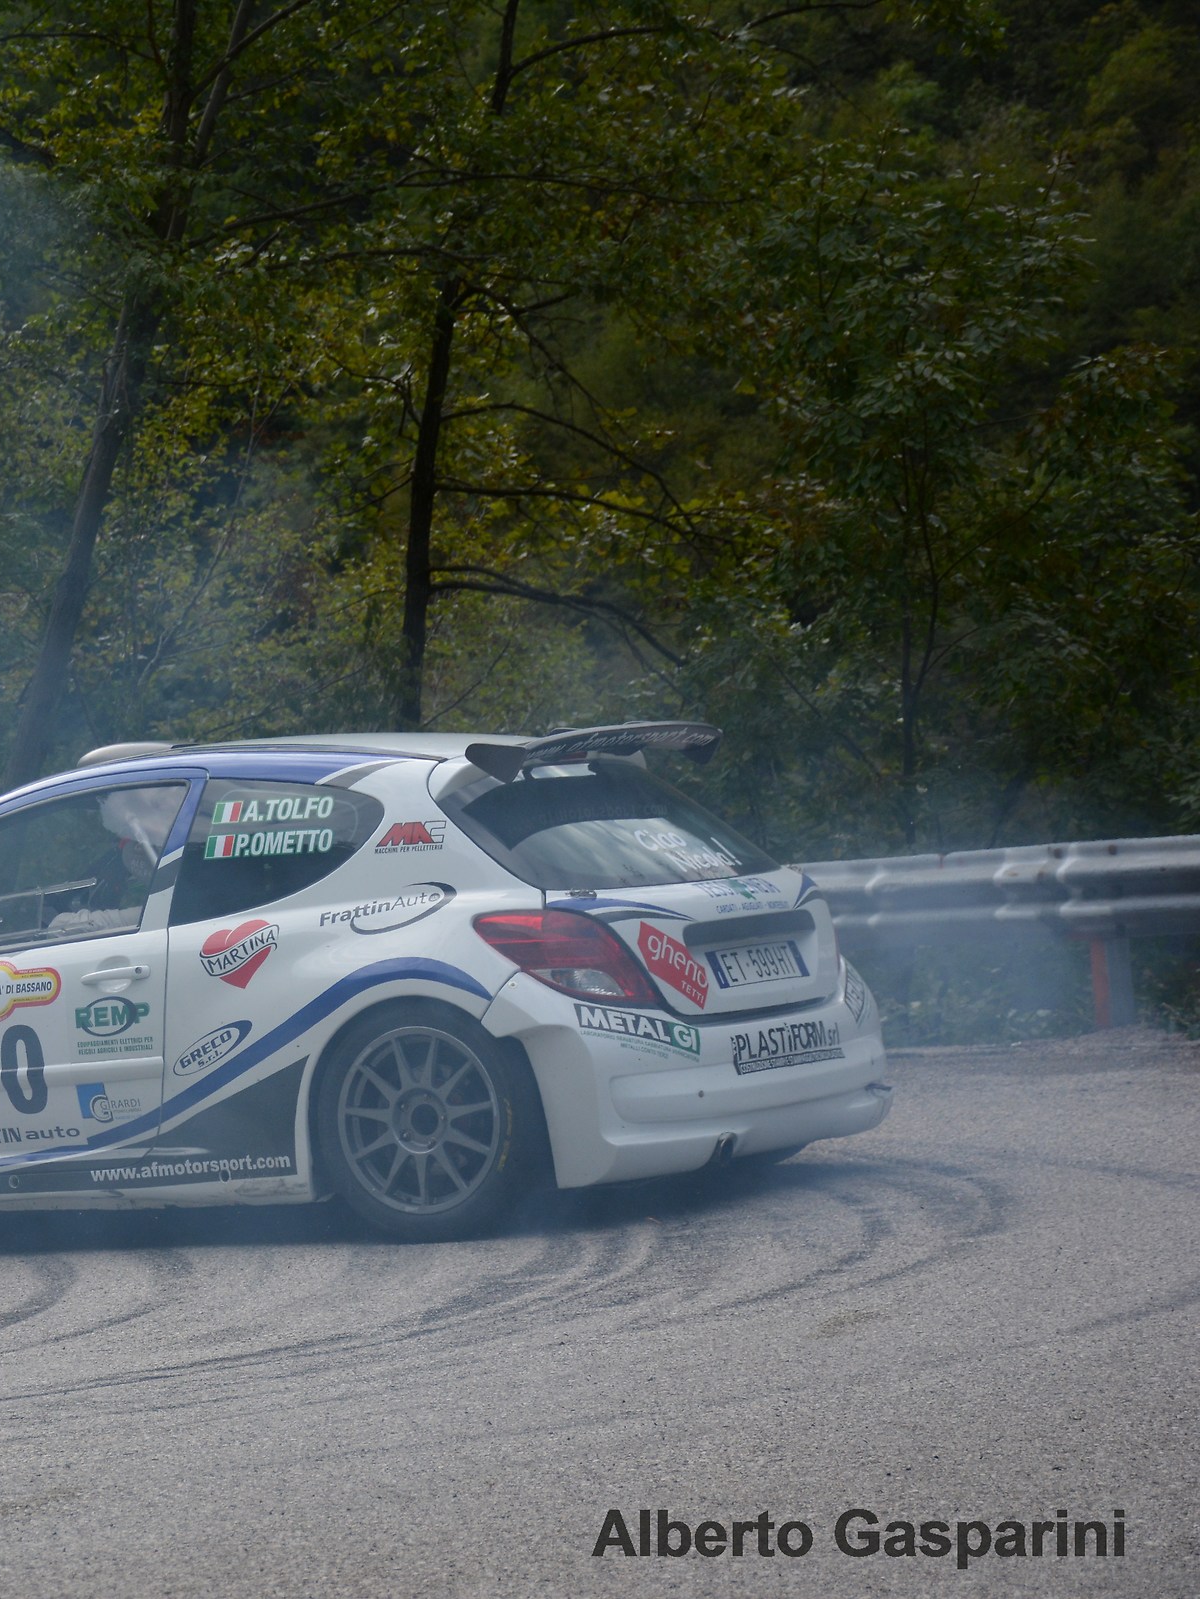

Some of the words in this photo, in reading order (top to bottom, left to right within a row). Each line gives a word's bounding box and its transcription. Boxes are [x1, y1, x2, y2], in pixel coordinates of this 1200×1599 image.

[242, 796, 334, 823] A.TOLFO
[234, 828, 334, 857] P.OMETTO
[634, 829, 687, 851] Ciao
[664, 836, 743, 873] Nicola!
[319, 891, 442, 927] FrattinAuto
[207, 929, 276, 974] MARTINA
[647, 934, 708, 989] gheno
[6, 984, 14, 995] DI
[16, 981, 52, 993] BASSANO
[681, 980, 705, 1004] TETTI
[75, 1002, 150, 1029] REMP
[828, 1023, 840, 1047] srl
[180, 1030, 232, 1069] GRECO
[197, 1050, 223, 1068] s.r.l.
[25, 1126, 80, 1140] auto
[91, 1154, 291, 1182] www.afmotorsport.com
